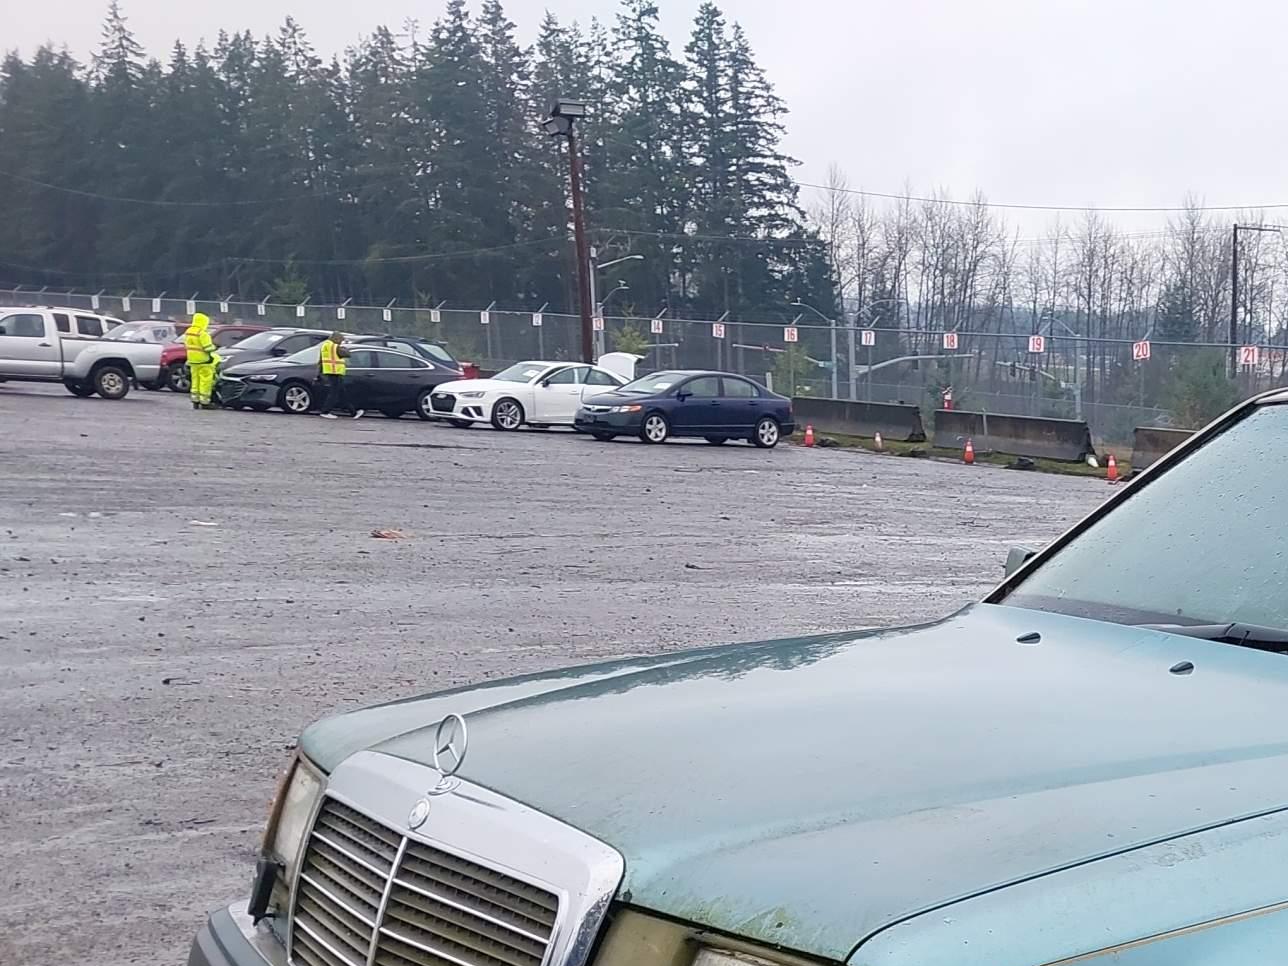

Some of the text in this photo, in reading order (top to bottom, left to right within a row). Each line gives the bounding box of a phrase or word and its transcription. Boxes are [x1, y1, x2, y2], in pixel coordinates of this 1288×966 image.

[652, 320, 663, 333] 14
[713, 324, 724, 337] 15
[786, 328, 796, 341] 16
[864, 332, 873, 345] 17
[945, 335, 956, 348] 18
[1031, 337, 1042, 351] 19
[1134, 343, 1148, 358] 20
[1243, 348, 1256, 363] 21
